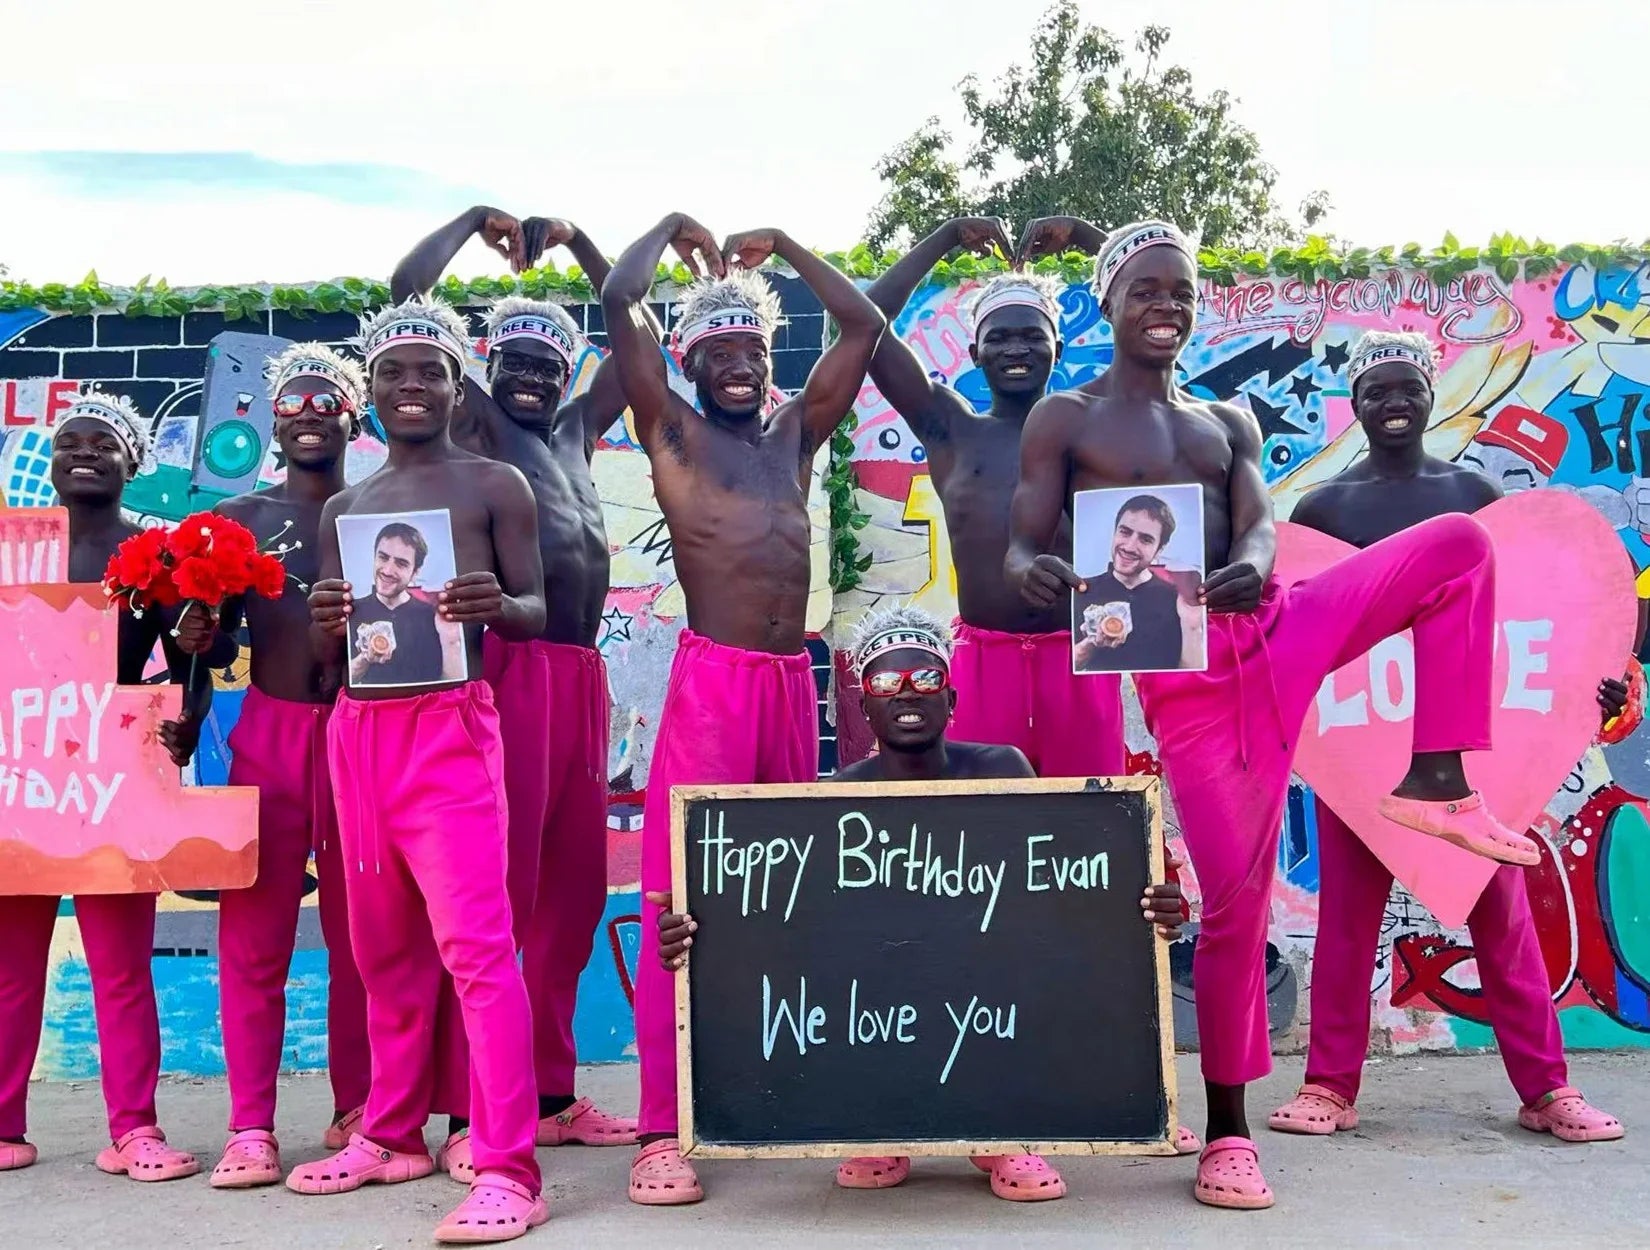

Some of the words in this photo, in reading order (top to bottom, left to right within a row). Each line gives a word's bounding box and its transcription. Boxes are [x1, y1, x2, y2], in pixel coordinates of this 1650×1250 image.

[1315, 619, 1554, 737] LOE
[697, 808, 814, 922] Happy
[837, 811, 1006, 933] Birthday
[1026, 833, 1109, 892] Evan
[762, 974, 827, 1061] We
[848, 978, 917, 1046] love
[939, 995, 1017, 1085] you
